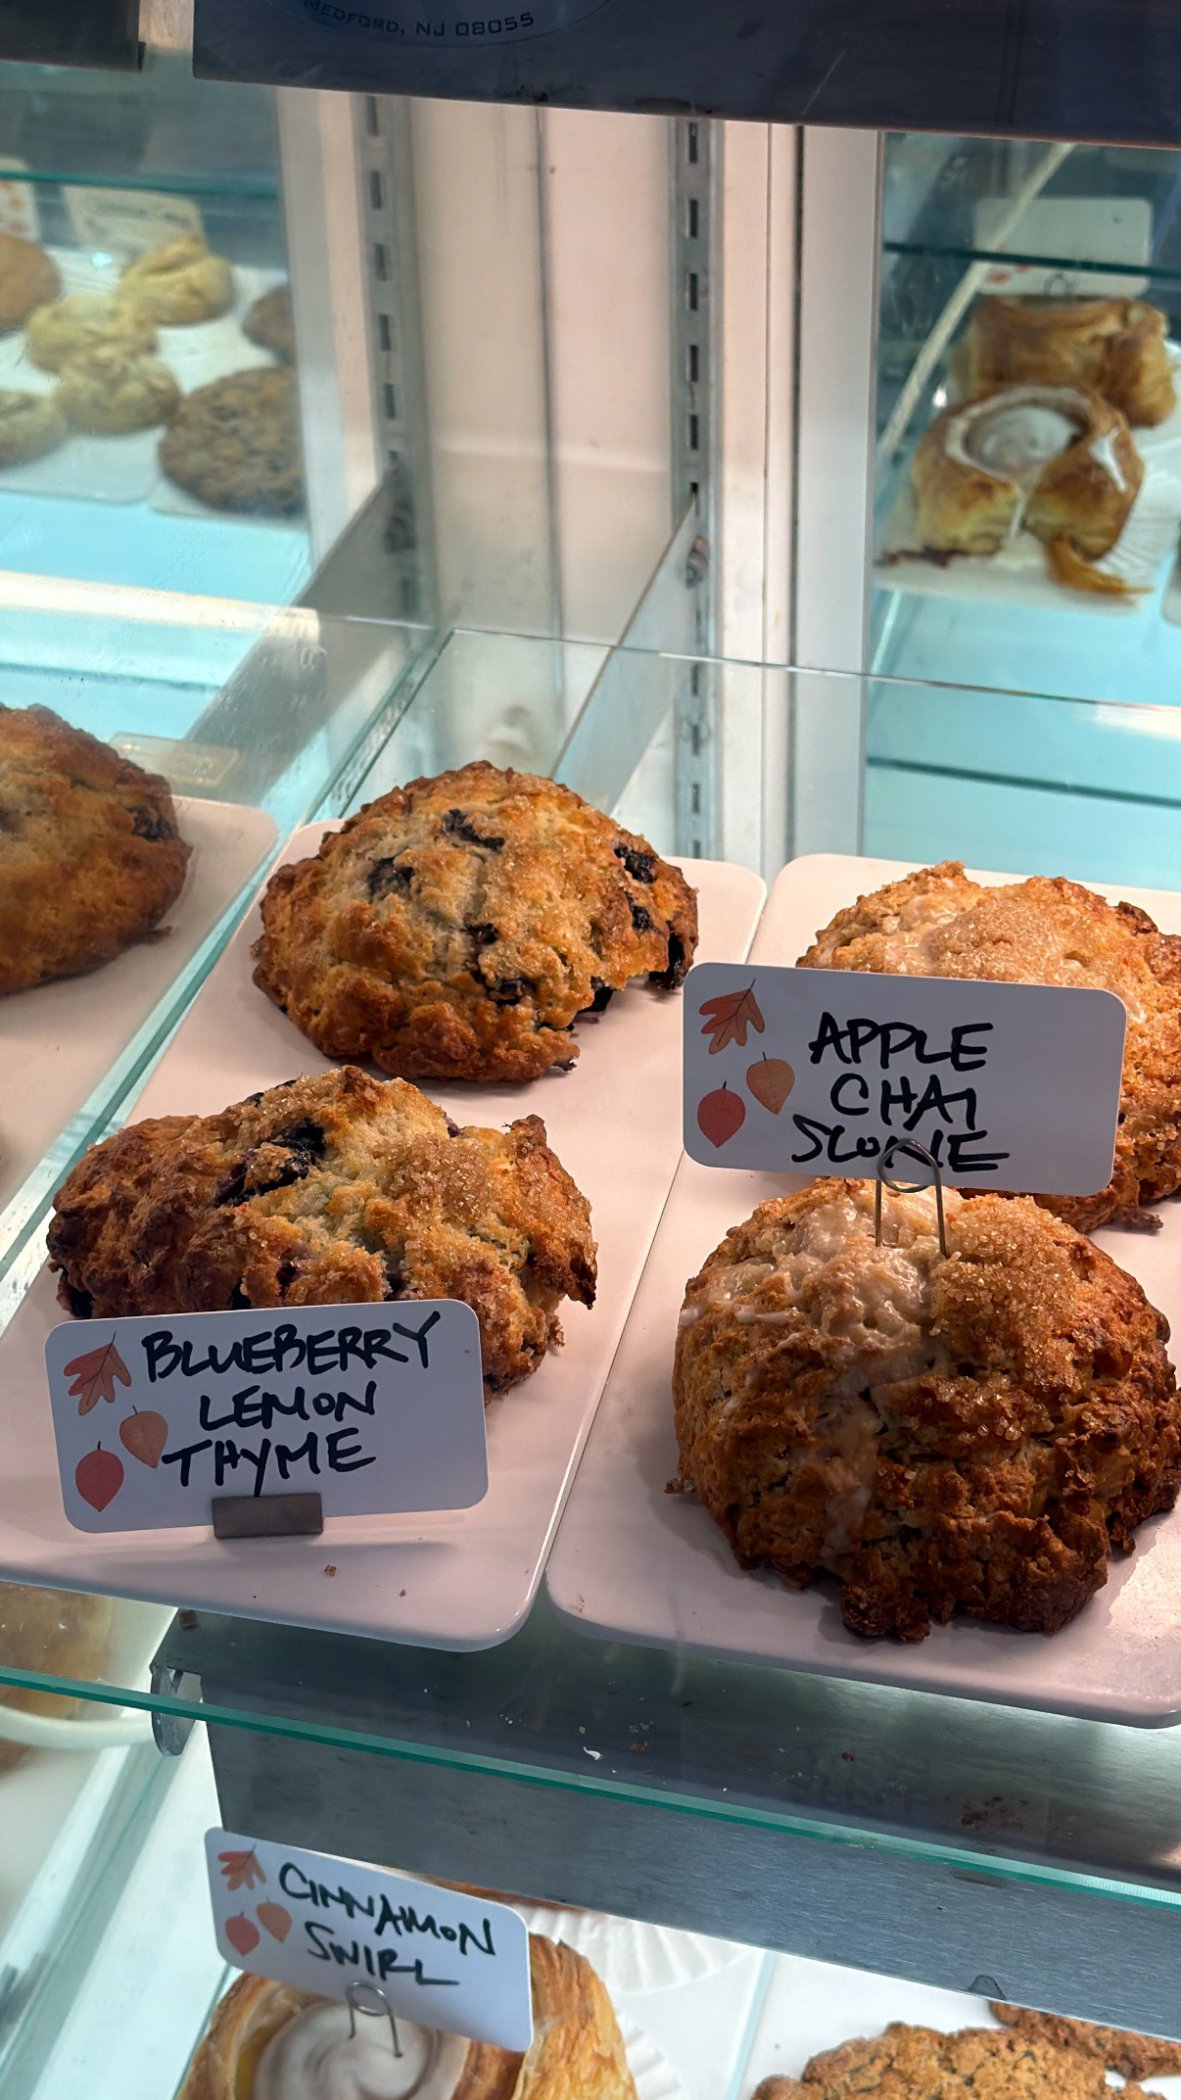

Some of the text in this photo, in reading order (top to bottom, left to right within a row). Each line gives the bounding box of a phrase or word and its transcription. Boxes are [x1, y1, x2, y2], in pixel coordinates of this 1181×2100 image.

[304, 0, 535, 36] MEDFORD, NJ 08055
[809, 1011, 994, 1071] APPLE
[830, 1073, 977, 1131] CHAI
[790, 1114, 1011, 1172] SCONE
[141, 1311, 441, 1383] BLUEBERRY
[200, 1381, 378, 1431] LEMON
[161, 1427, 377, 1498] THYME
[278, 1862, 496, 1956] CINNAMON
[304, 1921, 461, 1986] SWIRL
